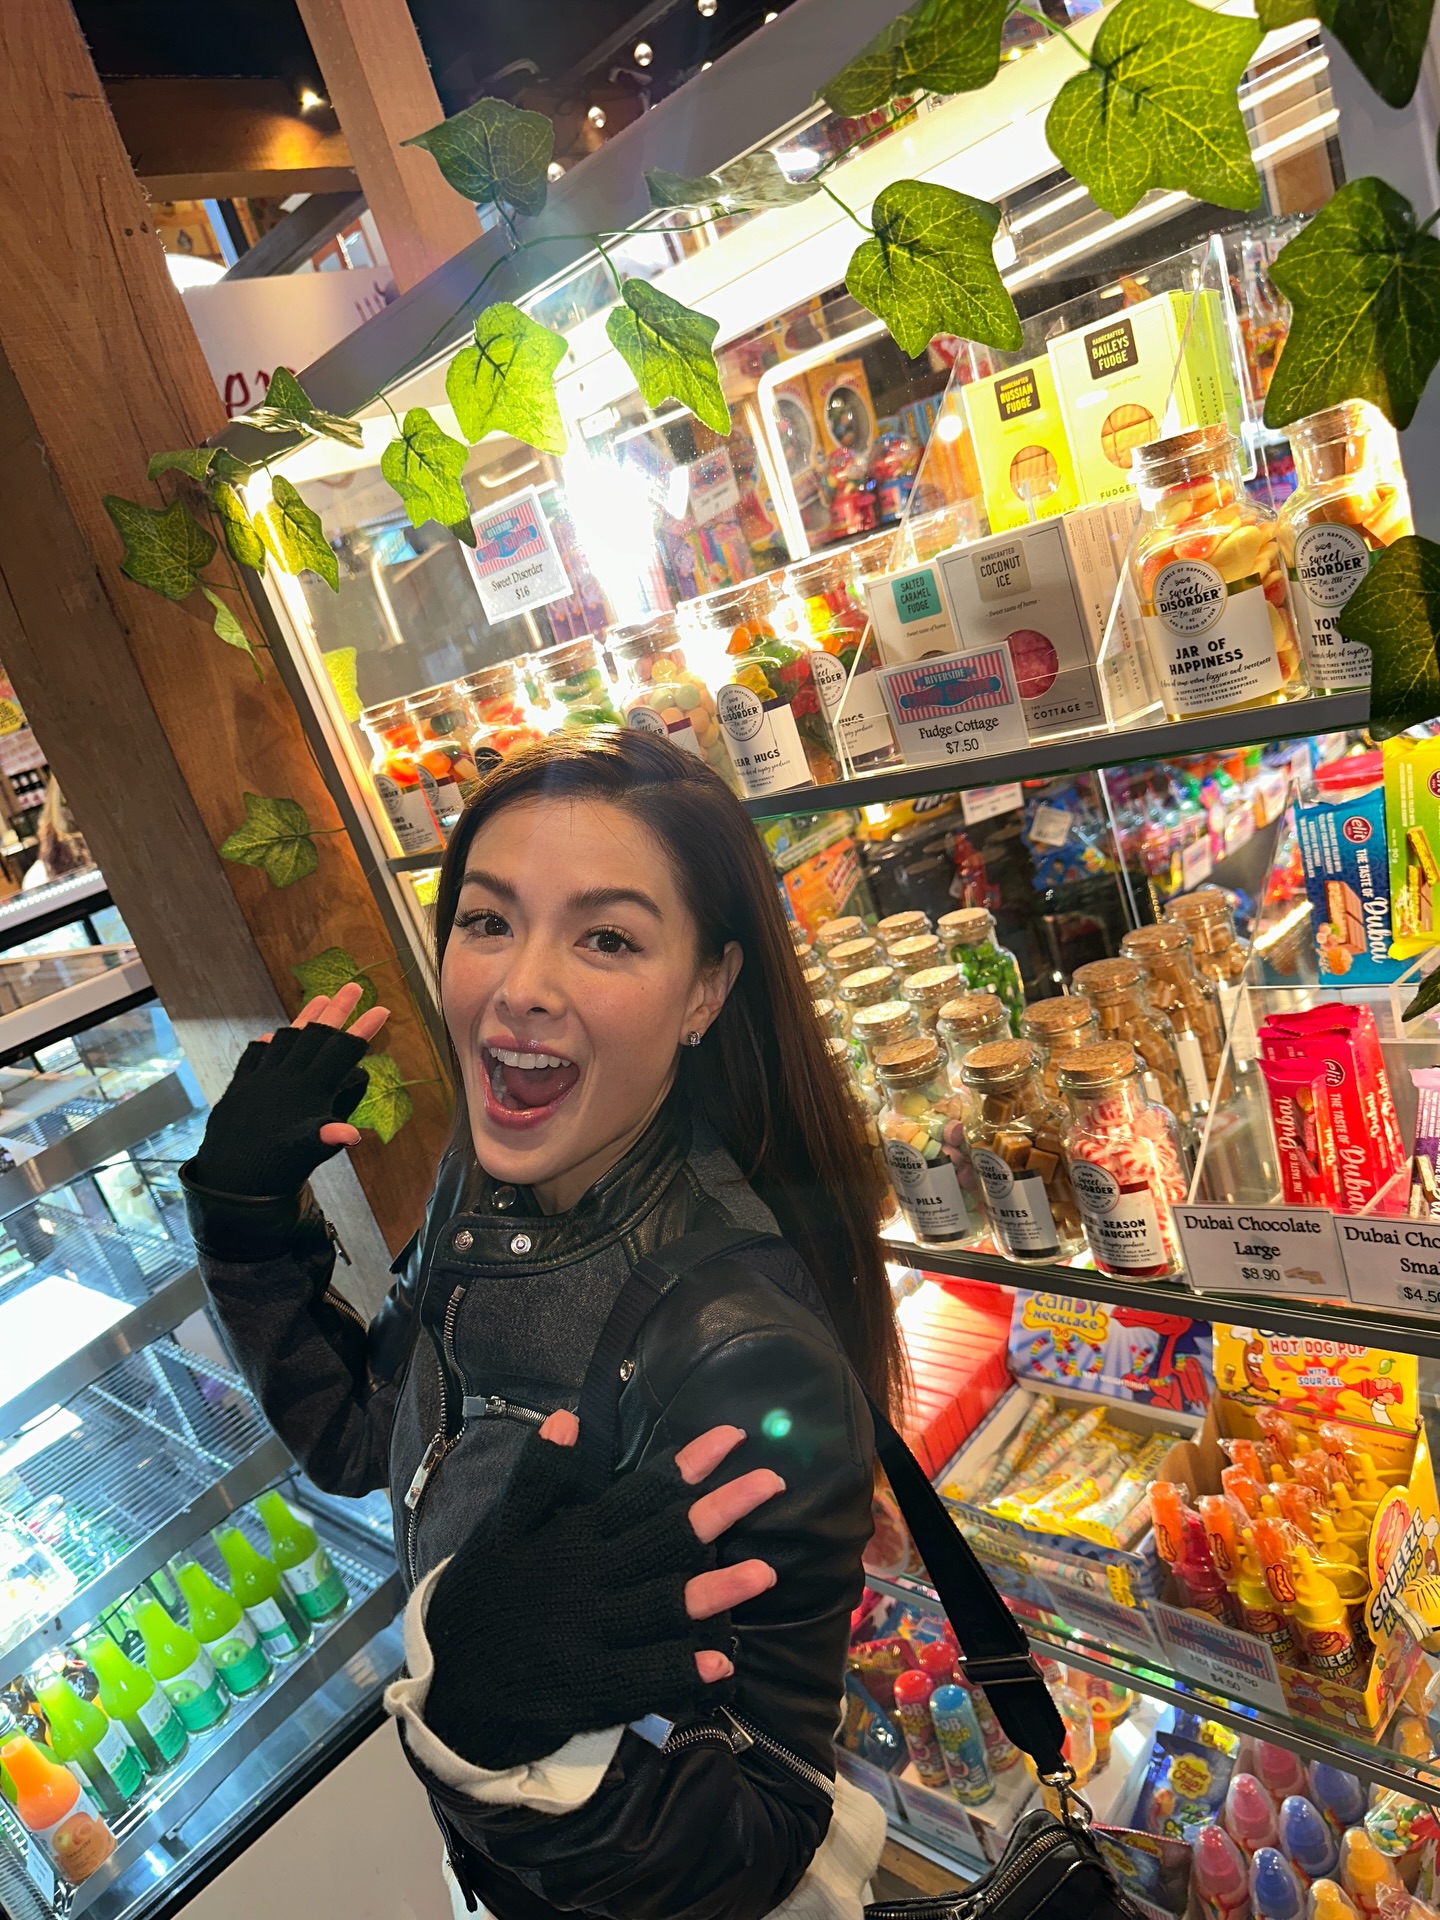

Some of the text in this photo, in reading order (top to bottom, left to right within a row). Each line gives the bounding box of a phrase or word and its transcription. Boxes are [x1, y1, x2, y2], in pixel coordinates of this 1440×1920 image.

[1091, 328, 1125, 346] HANDCRAFTED
[1091, 335, 1130, 361] BAILEYS
[1098, 350, 1129, 371] FUDGE
[999, 383, 1033, 405] RUSSIAN
[1006, 396, 1032, 414] FUDGE
[1100, 485, 1131, 499] FUDGE
[1301, 535, 1316, 556] SPRINKLE
[1326, 532, 1356, 550] HAPPINESS
[981, 547, 1015, 562] HANDCRAFTED
[1309, 549, 1345, 567] sweet
[979, 555, 1022, 579] COCONUT
[491, 562, 544, 592] Sweet Disorder
[900, 576, 925, 593] SALTED
[995, 573, 1012, 588] ICE
[1160, 571, 1176, 591] SPRINKLE
[1186, 567, 1214, 583] HAPPINESS
[515, 585, 531, 600] $16
[900, 588, 932, 605] CARAMEL
[1169, 582, 1204, 600] sweet
[1309, 587, 1318, 596] AND
[1348, 578, 1358, 589] FUN
[907, 601, 930, 615] FUDGE
[988, 599, 1039, 618] Sweet taste of home
[1169, 619, 1179, 628] AND
[1185, 623, 1200, 631] DASH
[1207, 608, 1216, 619] FUN
[905, 630, 919, 639] Sweet
[918, 628, 930, 636] taste
[935, 622, 947, 631] home
[1175, 637, 1226, 660] JAR OF
[1311, 634, 1334, 647] THE
[1169, 648, 1244, 676] HAPPINESS
[1229, 664, 1242, 675] and
[1243, 656, 1272, 671] sweetness
[924, 668, 966, 686] RIVERSIDE
[1180, 675, 1248, 695] SUPPLEMENT RECOMMENDED
[1194, 679, 1259, 700] LITTLE EXTRA HAPPINESS
[1215, 690, 1243, 701] EVERYONE
[1033, 703, 1081, 721] COTTAGE
[918, 715, 1000, 740] Fudge Cottage
[945, 738, 980, 755] $7.50
[754, 749, 781, 764] HUGS
[1350, 819, 1368, 841] elit
[1355, 848, 1374, 898] THE TASTE OF
[1363, 896, 1392, 964] Dubai
[1326, 1060, 1341, 1086] elit
[1275, 1095, 1297, 1152] Dubai
[1330, 1093, 1350, 1145] THE TASTE OF
[1288, 1151, 1303, 1193] THE TASTE OF
[916, 1196, 943, 1206] PILLS
[1000, 1209, 1028, 1218] BITES
[1102, 1219, 1146, 1229] SEASON
[1185, 1215, 1322, 1234] Dubai Chocolate
[1344, 1225, 1401, 1245] Dubai
[1233, 1241, 1281, 1261] Large
[1241, 1267, 1281, 1282] $8.90
[1268, 1338, 1300, 1354] HOT
[1304, 1340, 1333, 1356] DOG
[1297, 1376, 1344, 1386] SOUR GEL
[1308, 1368, 1328, 1376] WITH
[1370, 1506, 1424, 1633] SQUEEZE
[1271, 1641, 1294, 1654] DOG
[1190, 1654, 1259, 1689] Hot Dog Pop
[1337, 1661, 1358, 1677] DOG
[1210, 1673, 1242, 1692] $4.50
[1178, 1760, 1208, 1780] Chupa
[1173, 1768, 1204, 1792] Chups
